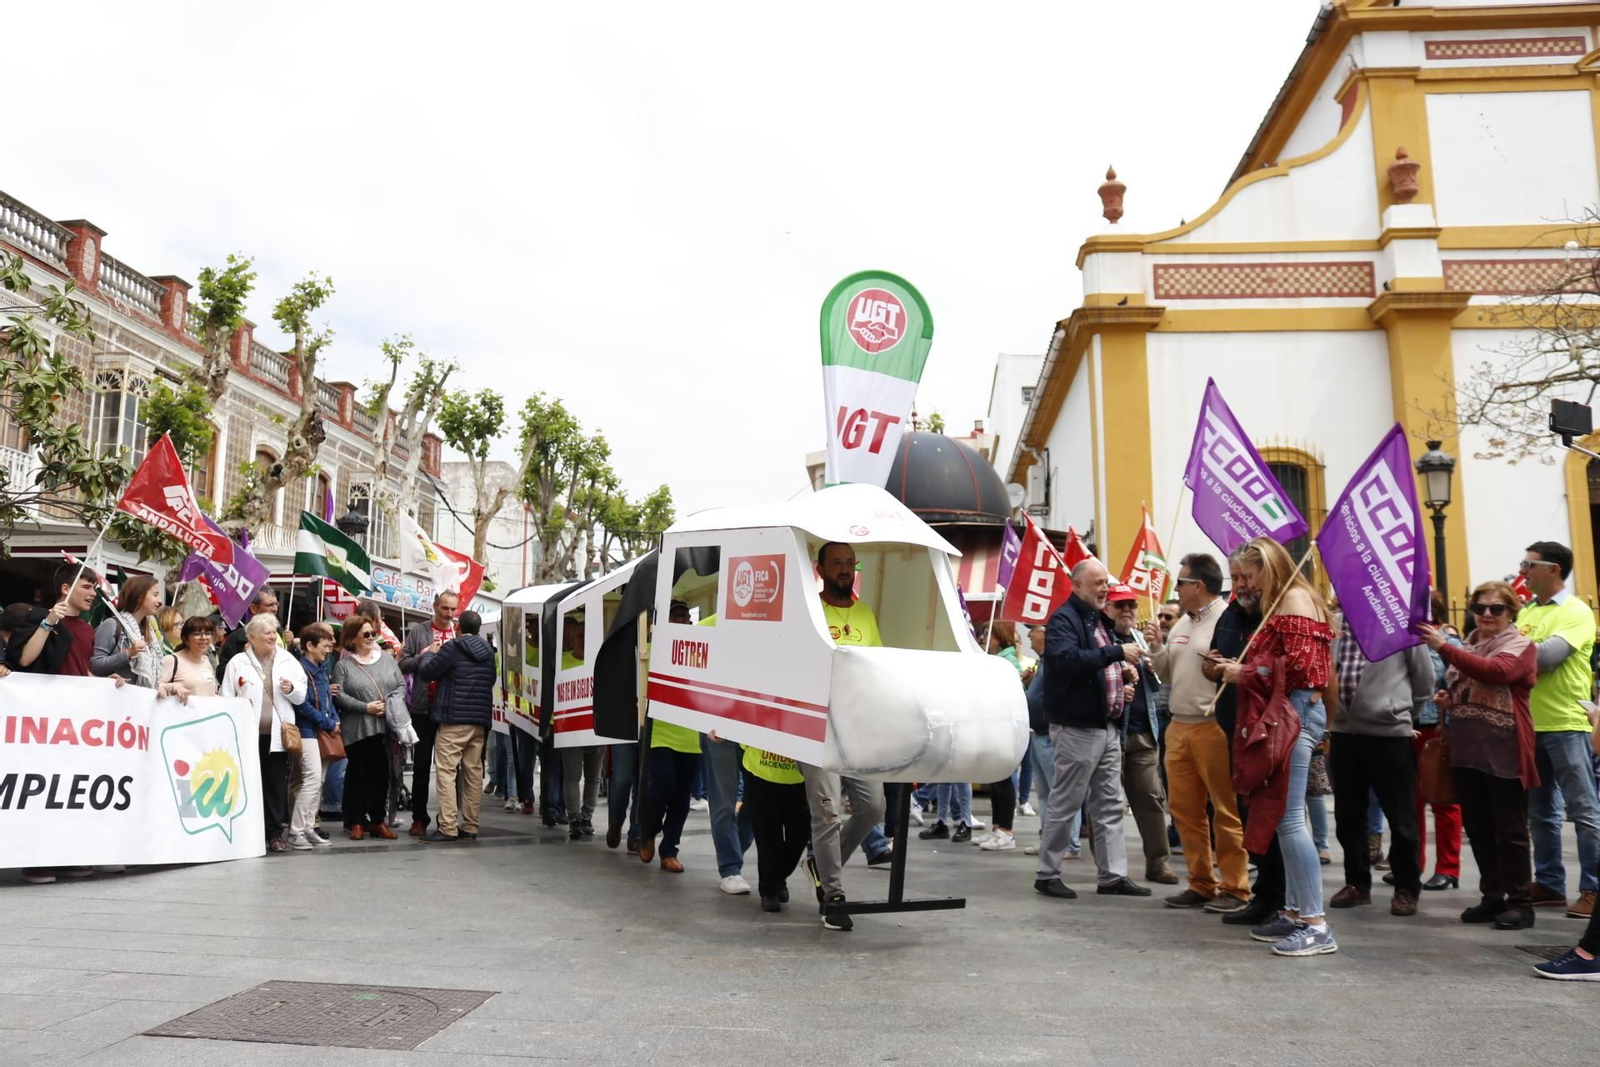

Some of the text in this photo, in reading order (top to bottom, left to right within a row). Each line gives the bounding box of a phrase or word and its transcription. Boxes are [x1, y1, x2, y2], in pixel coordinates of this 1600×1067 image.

[855, 297, 900, 329] UGT
[1212, 482, 1223, 496] la
[372, 567, 435, 597] Café Bar
[755, 570, 769, 582] FICA
[1360, 549, 1373, 564] la
[1367, 563, 1410, 629] ciudadanía
[1361, 585, 1395, 636] Andalucía
[671, 639, 709, 670] UGTREN
[0, 716, 150, 751] INACIÓN
[759, 760, 791, 770] HACIENDO
